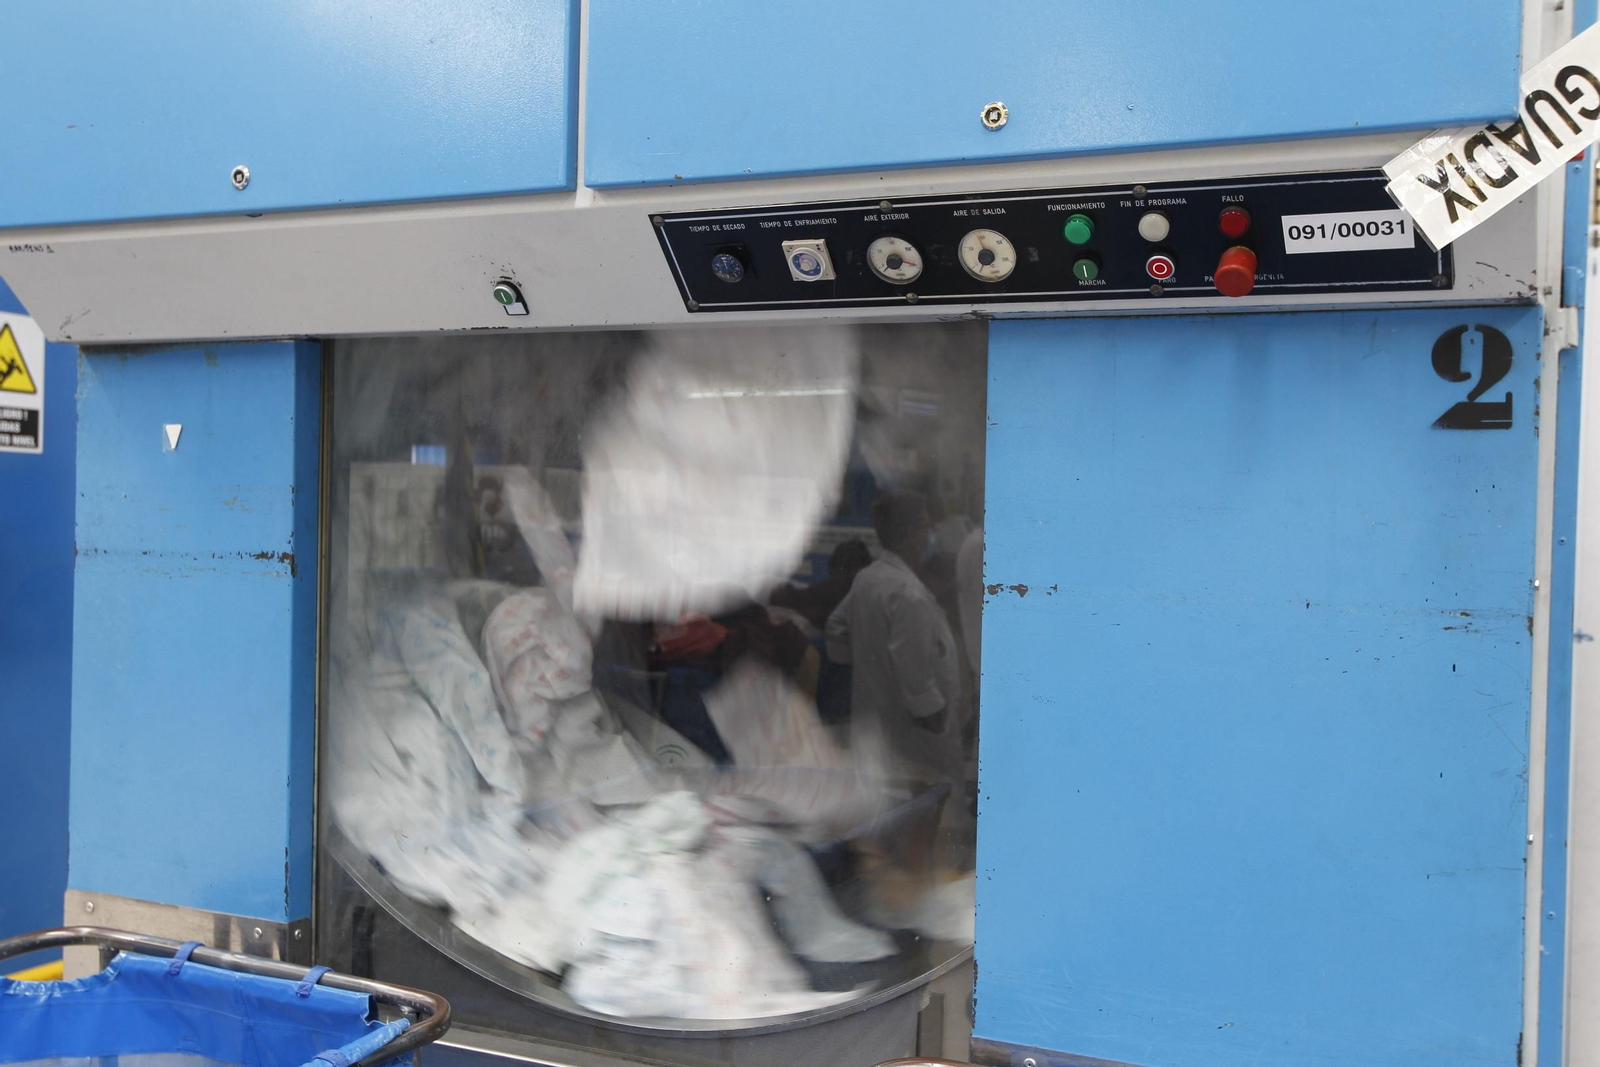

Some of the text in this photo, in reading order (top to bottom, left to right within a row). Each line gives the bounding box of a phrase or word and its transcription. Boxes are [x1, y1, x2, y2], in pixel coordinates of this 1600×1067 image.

[1415, 65, 1600, 224] GUADIX
[1119, 197, 1188, 208] FIN DE PROGRAMA
[1221, 194, 1244, 203] FALLO
[1047, 201, 1106, 211] FUNCIONAMIENTO
[864, 212, 910, 222] AIRE EXTERIOR
[953, 207, 1007, 217] AIRE DE SALIDA
[794, 217, 838, 227] ENFRIAMIENTO
[688, 225, 710, 233] TIEMPO
[722, 223, 746, 231] SECADO
[1287, 218, 1407, 241] 091/00031
[1078, 279, 1107, 287] MARCHA
[1431, 324, 1514, 430] 2
